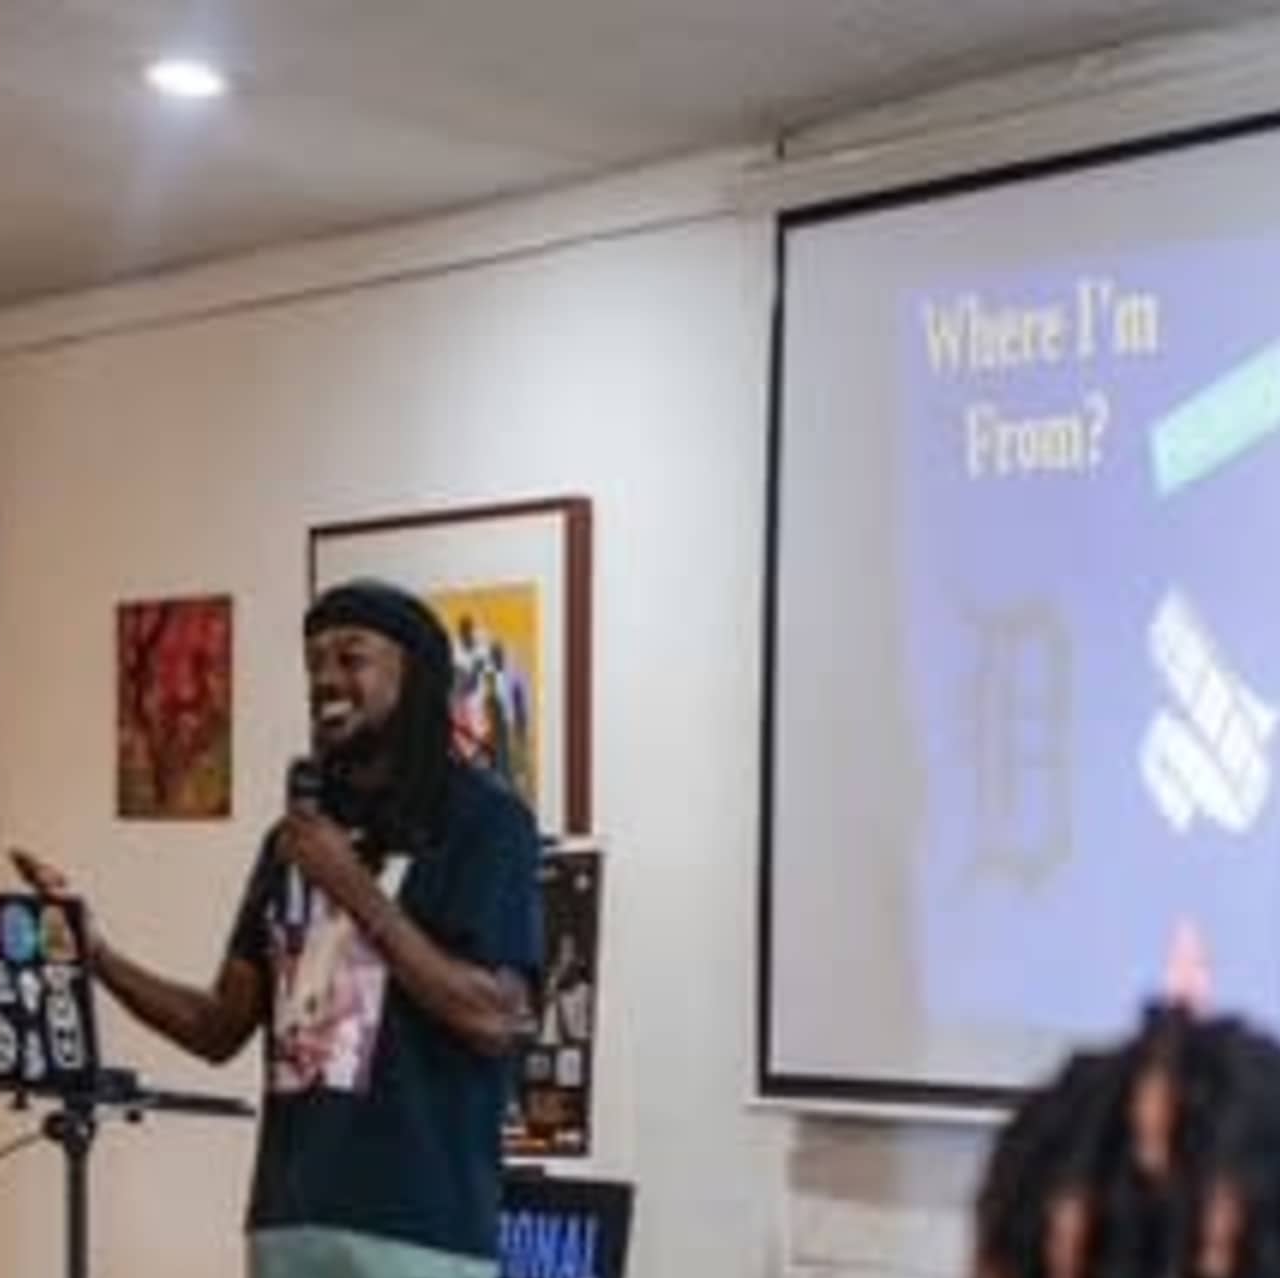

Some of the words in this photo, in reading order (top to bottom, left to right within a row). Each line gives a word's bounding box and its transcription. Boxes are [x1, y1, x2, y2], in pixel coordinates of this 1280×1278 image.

[921, 294, 1066, 373] Where
[1074, 277, 1159, 359] I'm
[966, 393, 1109, 475] From?
